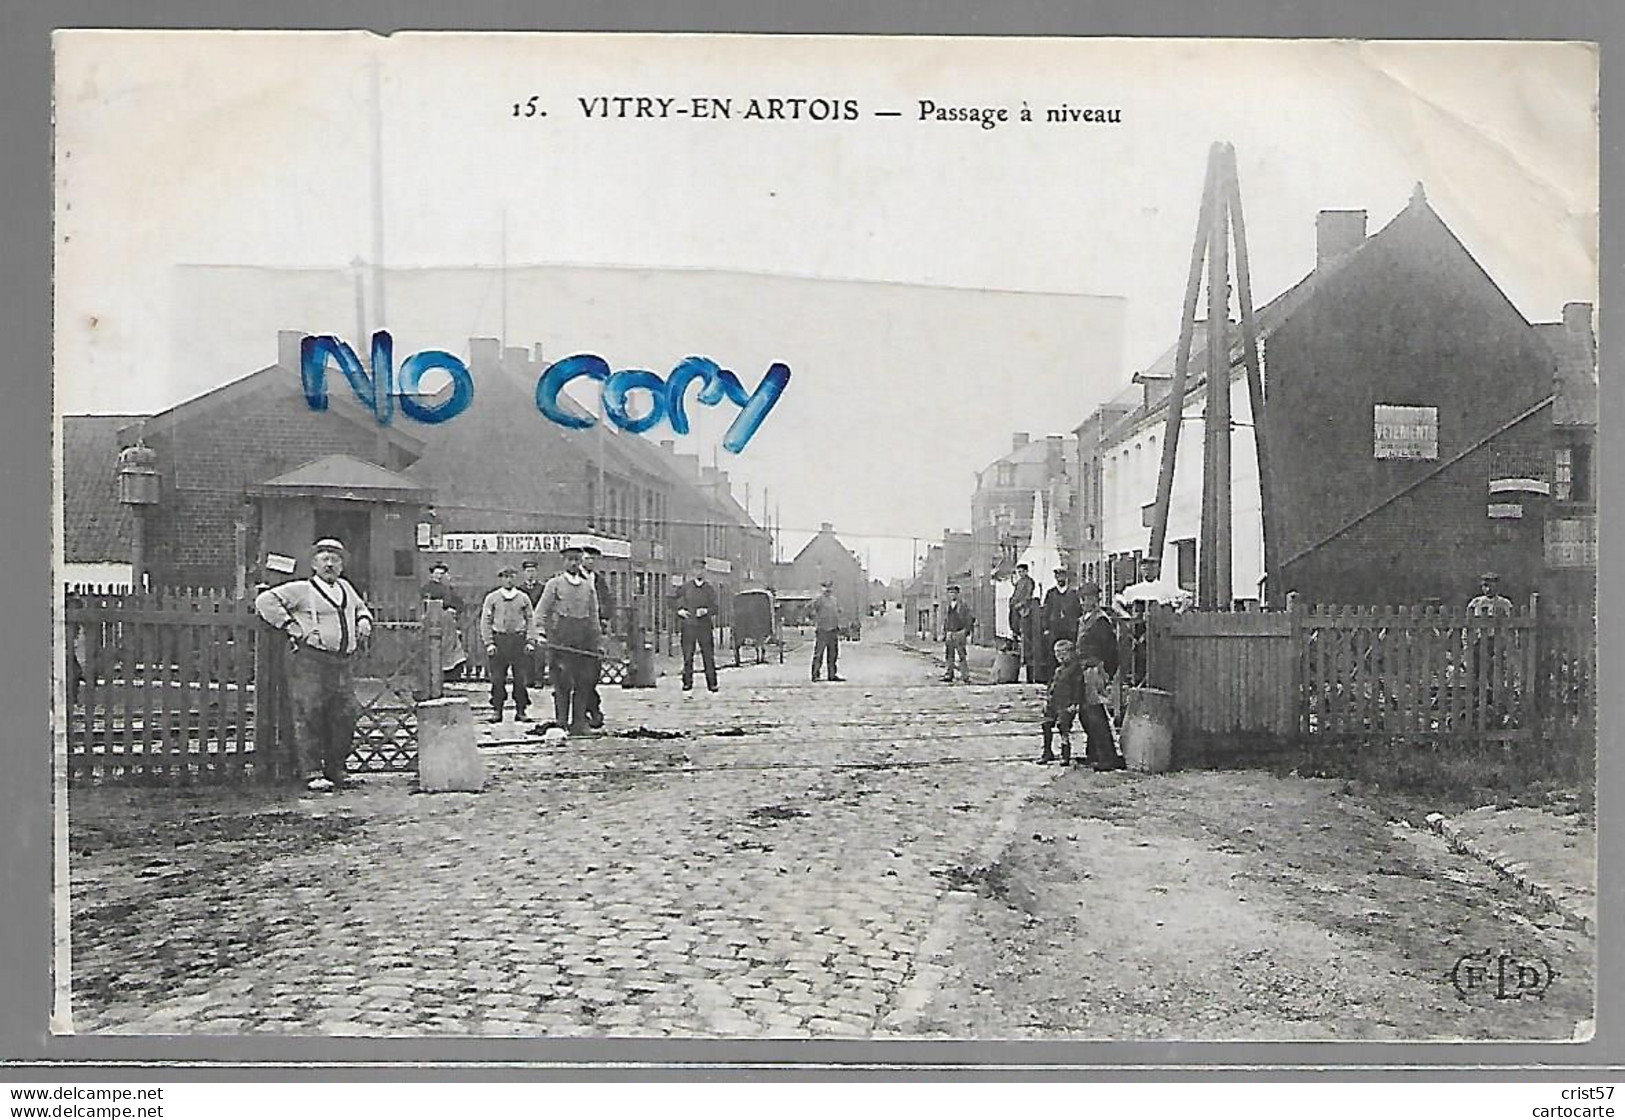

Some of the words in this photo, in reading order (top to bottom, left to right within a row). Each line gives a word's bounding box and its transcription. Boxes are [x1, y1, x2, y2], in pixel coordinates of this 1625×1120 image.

[447, 538, 463, 550] DE
[472, 538, 488, 550] LA
[496, 535, 572, 551] BRETAGNE
